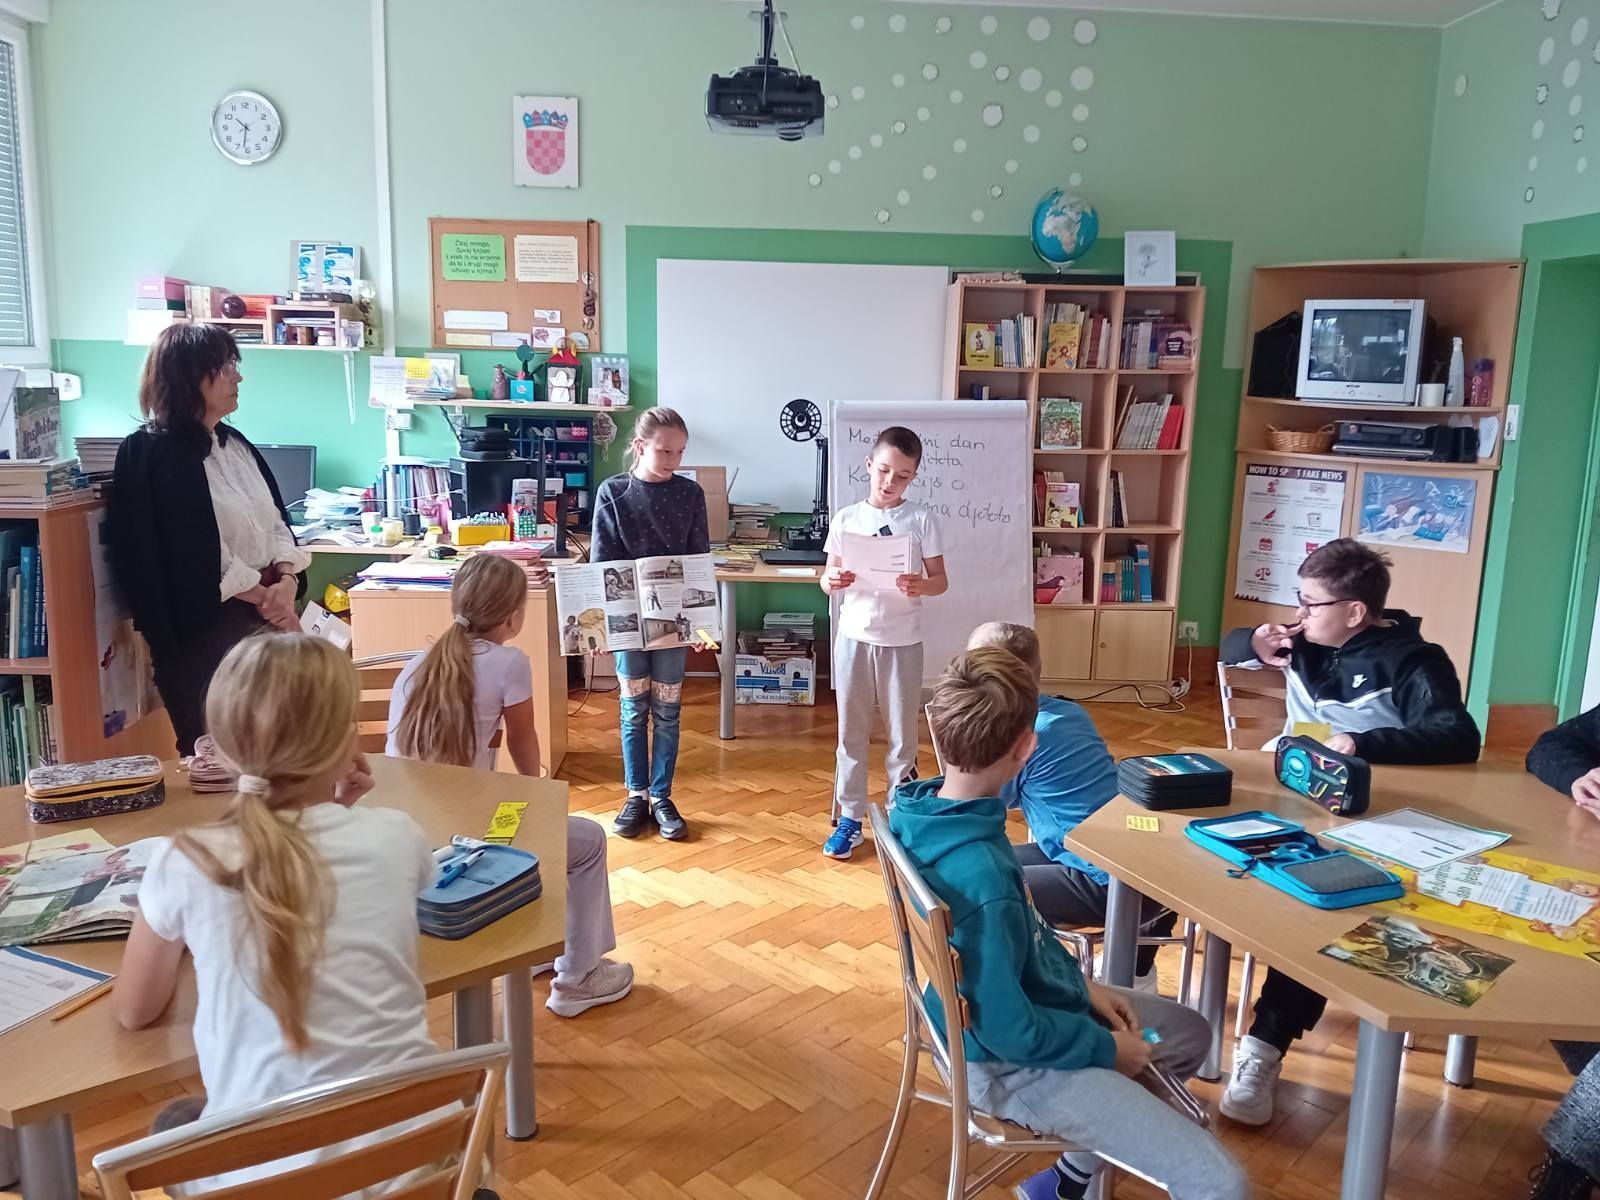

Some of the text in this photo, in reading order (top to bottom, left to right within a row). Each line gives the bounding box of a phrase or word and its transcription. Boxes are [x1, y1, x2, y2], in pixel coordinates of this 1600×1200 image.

[950, 434, 985, 451] dan
[1249, 465, 1267, 475] HOW
[1268, 466, 1279, 475] TO
[1302, 470, 1320, 479] FAKE
[1321, 471, 1343, 480] NEWS
[951, 479, 965, 491] o
